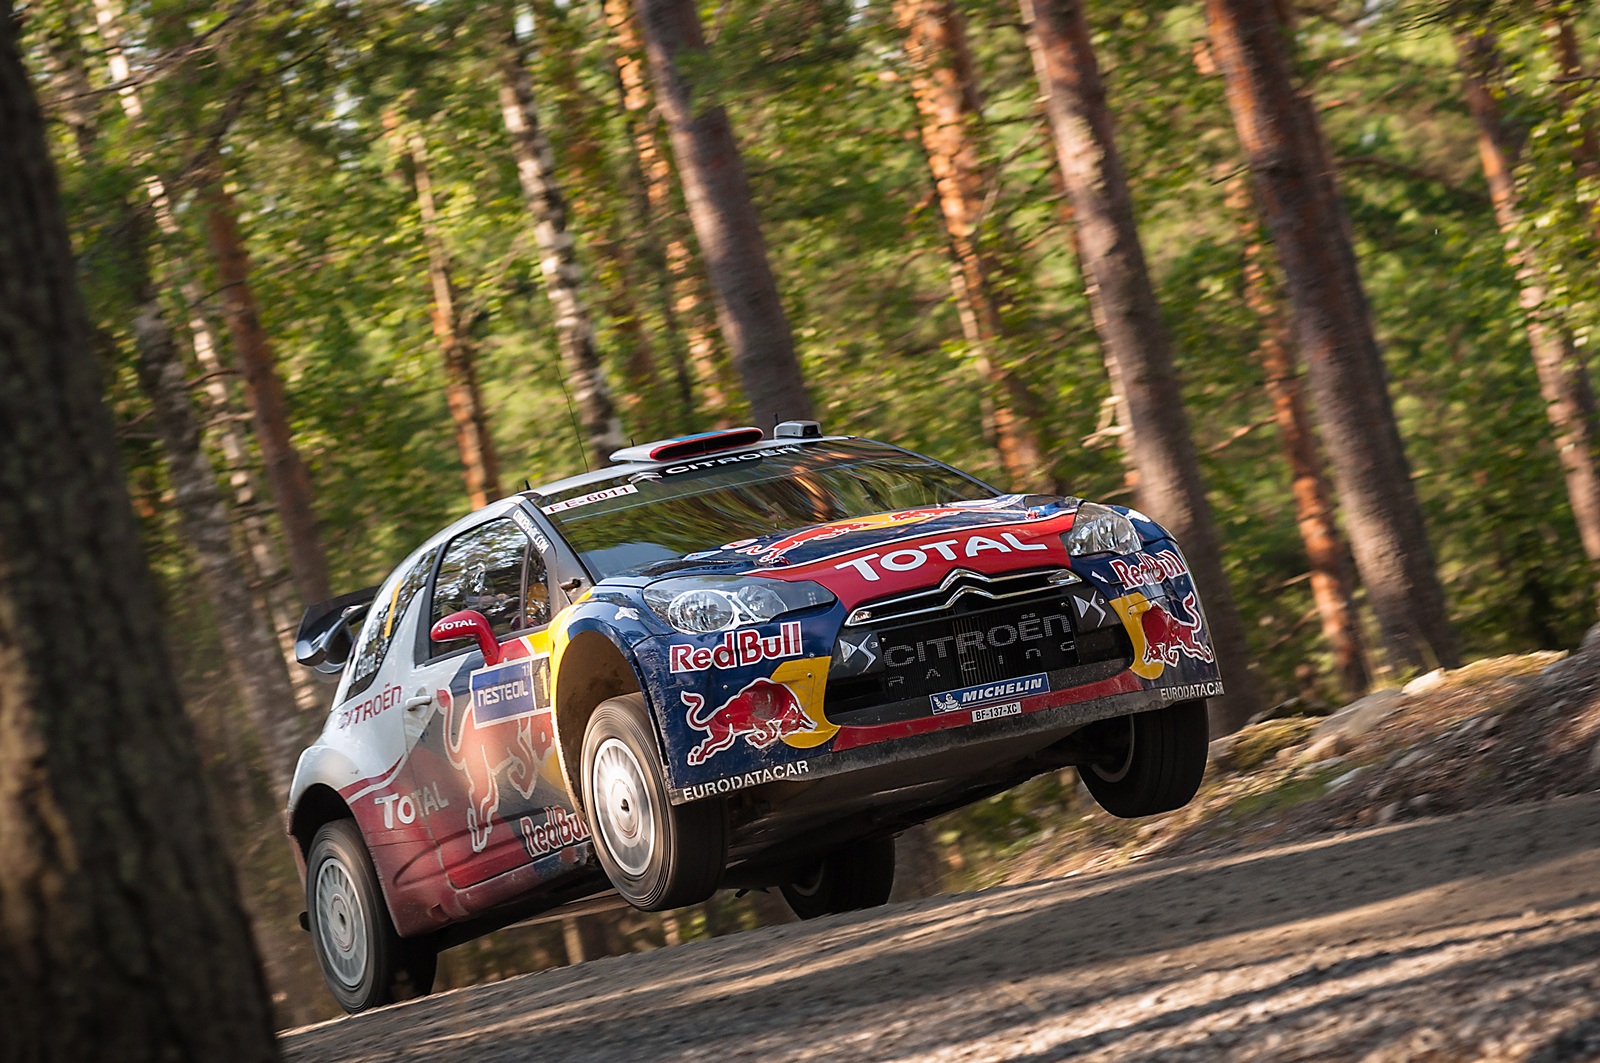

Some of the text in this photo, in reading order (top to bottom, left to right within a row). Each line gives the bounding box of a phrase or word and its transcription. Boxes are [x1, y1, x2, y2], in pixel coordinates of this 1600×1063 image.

[549, 487, 629, 512] FE-6011
[834, 533, 1048, 581] TOTAL
[1109, 549, 1187, 590] Red Bull
[439, 619, 477, 632] TOTAL
[669, 621, 803, 673] Red Bull
[883, 612, 1071, 667] CITROËN
[340, 682, 402, 730] CITROËN
[962, 678, 1042, 703] MICHELIN
[975, 704, 1018, 721] BF-137-XC
[682, 760, 809, 801] EURODATACAR
[374, 781, 450, 829] TOTAL
[520, 805, 592, 857] Red Bu
